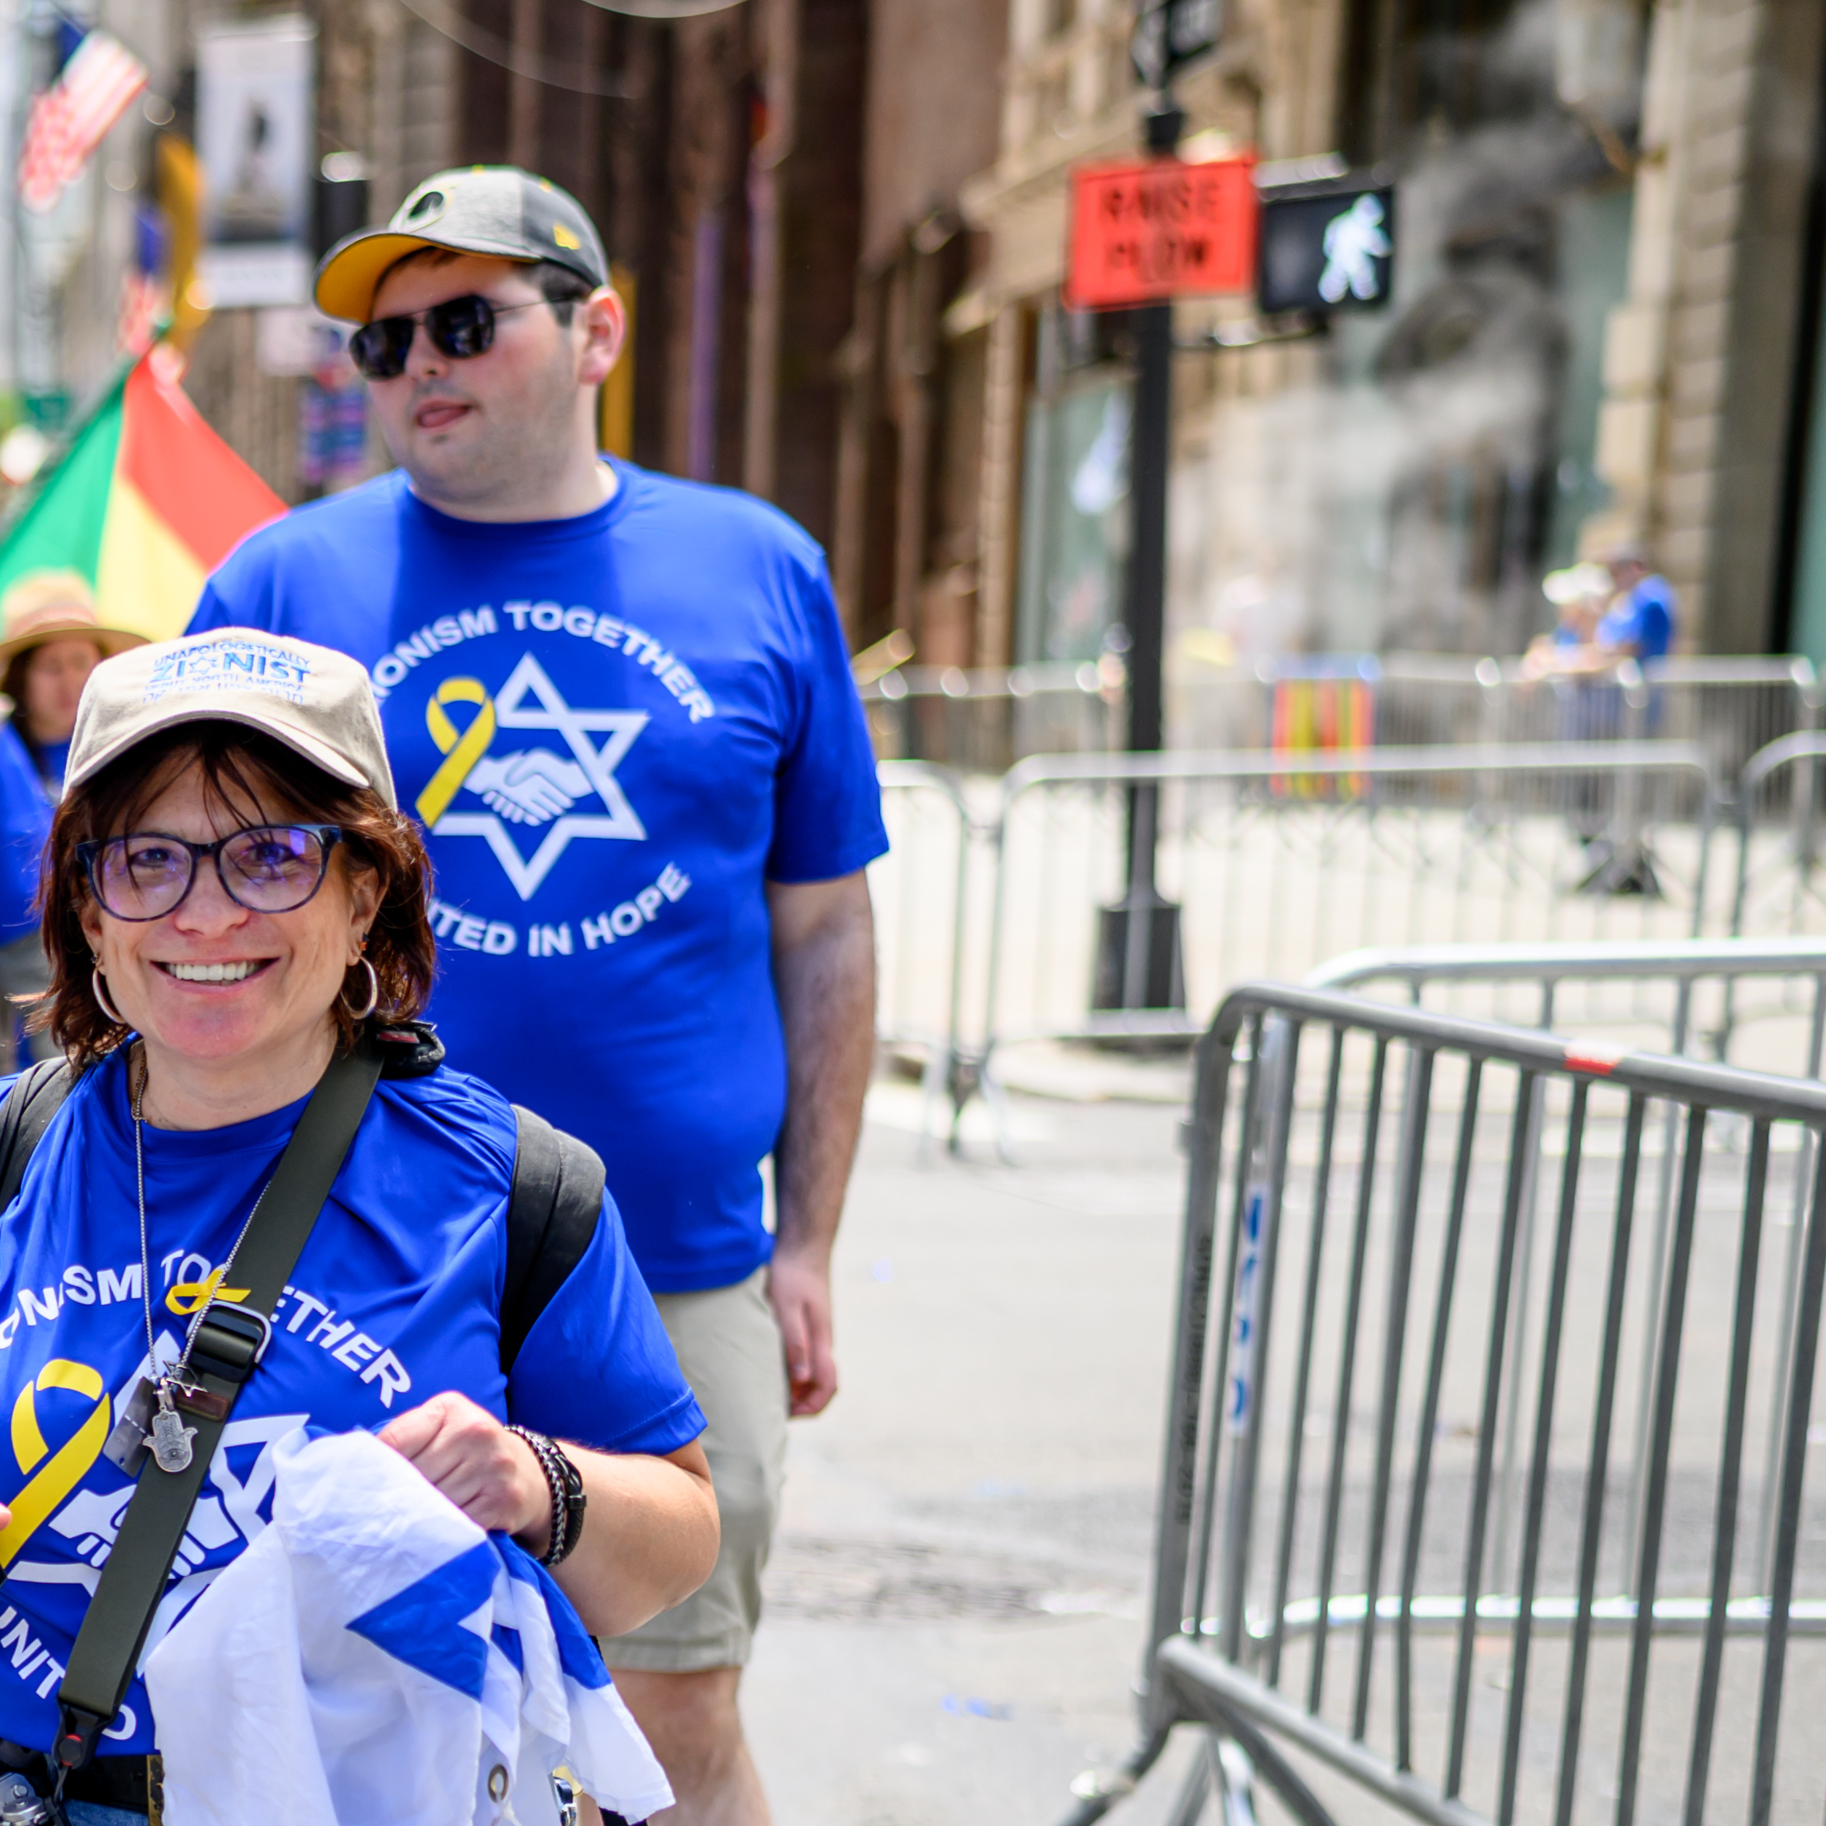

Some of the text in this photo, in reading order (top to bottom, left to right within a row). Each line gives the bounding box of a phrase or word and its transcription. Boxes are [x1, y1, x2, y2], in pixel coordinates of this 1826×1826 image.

[154, 639, 310, 667] UNAPOLOGETICALLY
[246, 676, 303, 692] AMERICA
[371, 598, 715, 724] IONISM TOGETHER
[427, 861, 693, 958] ITED IN HOPE
